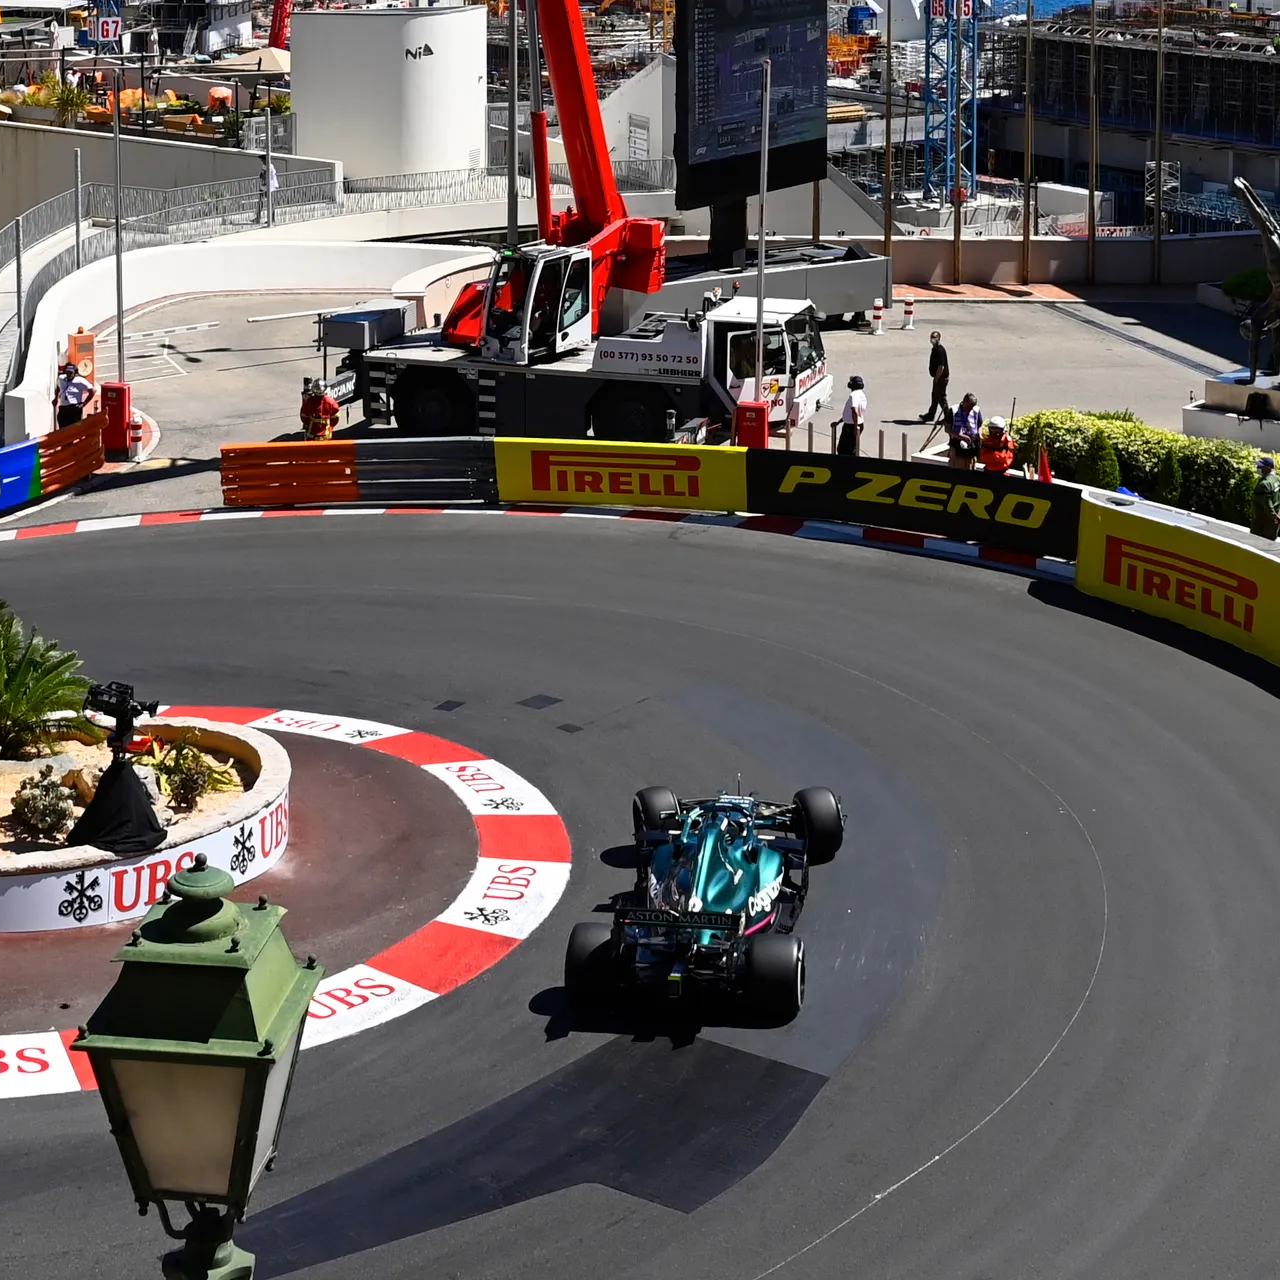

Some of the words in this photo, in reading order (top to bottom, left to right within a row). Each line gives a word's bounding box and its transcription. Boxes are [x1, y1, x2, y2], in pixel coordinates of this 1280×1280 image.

[599, 350, 615, 361] (00
[617, 351, 639, 362] 377)
[641, 353, 653, 362] 93
[656, 353, 669, 363] 50
[671, 354, 683, 363] 72
[686, 355, 699, 365] 50
[658, 367, 701, 377] LIEBHERR
[530, 450, 701, 497] PIRELLI
[778, 466, 842, 494] P
[845, 471, 1052, 528] ZERO
[1103, 535, 1259, 633] PIRELLI
[273, 716, 340, 732] UBS
[445, 765, 505, 794] UBS
[482, 863, 537, 901] UBS
[627, 910, 676, 922] ASTON
[677, 913, 732, 925] MARTIN
[307, 977, 396, 1020] UBS
